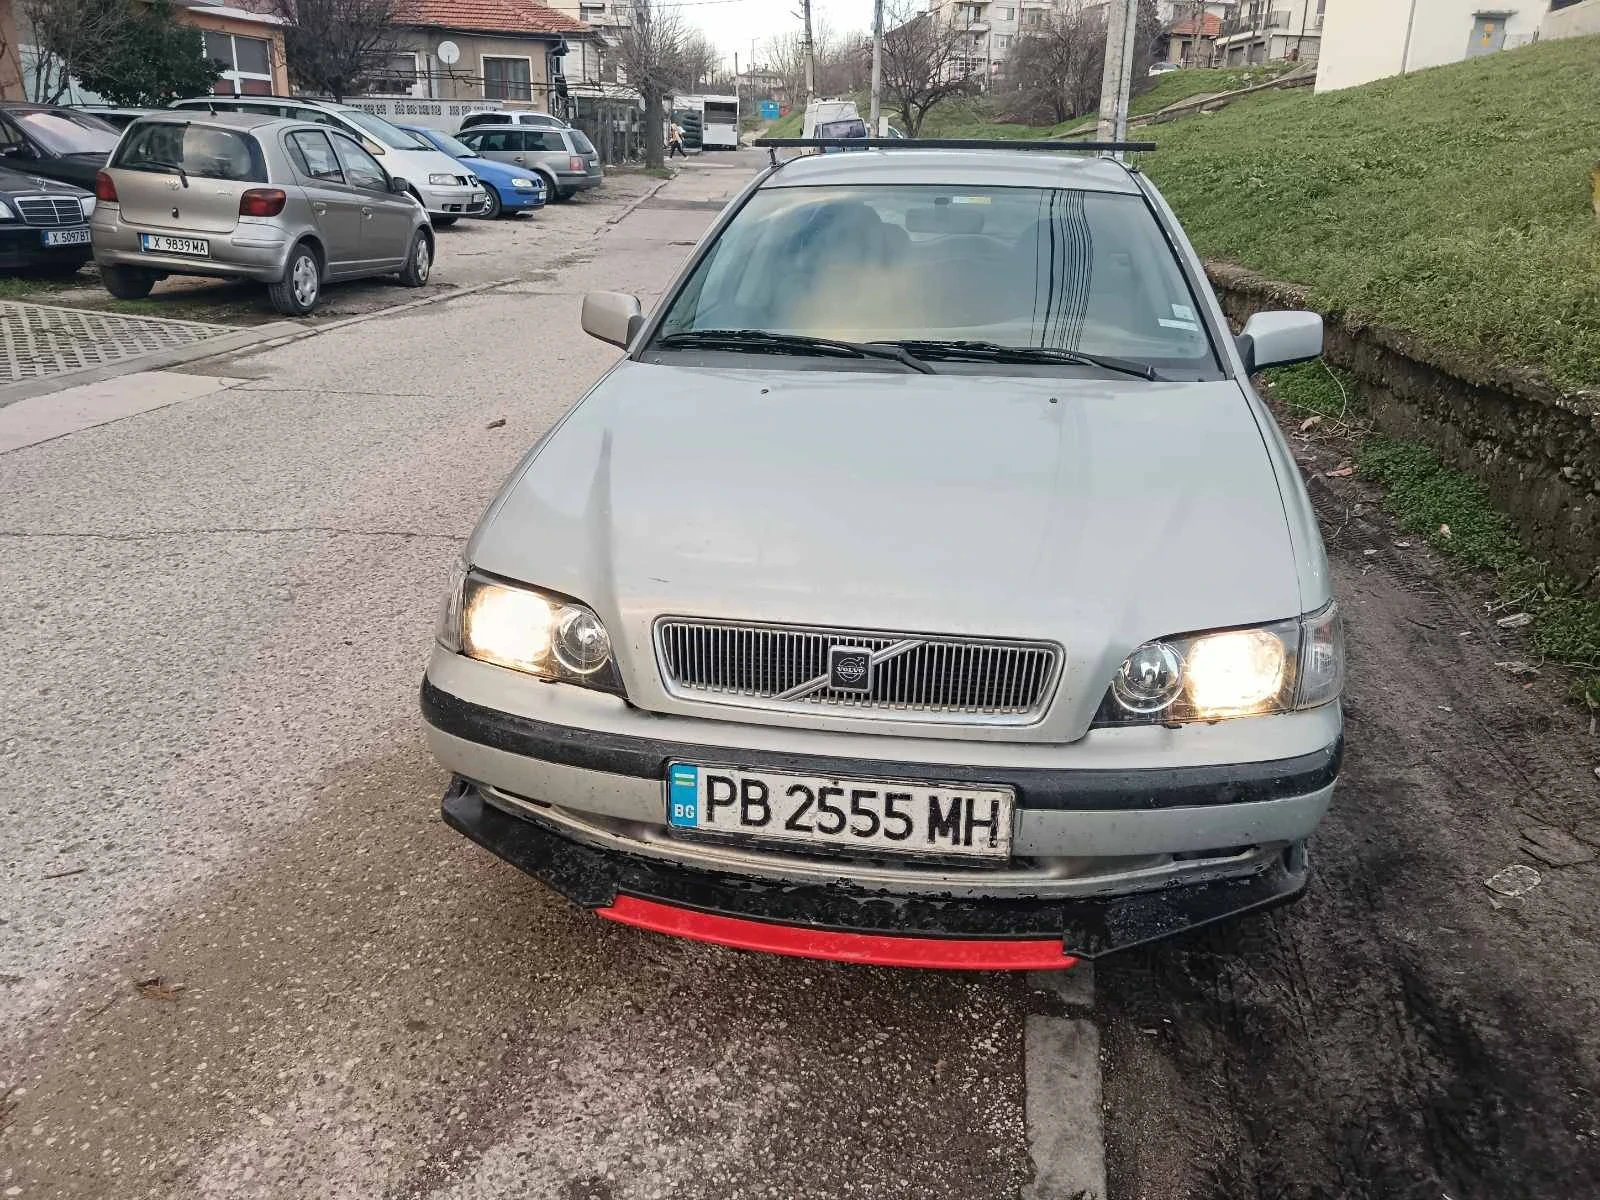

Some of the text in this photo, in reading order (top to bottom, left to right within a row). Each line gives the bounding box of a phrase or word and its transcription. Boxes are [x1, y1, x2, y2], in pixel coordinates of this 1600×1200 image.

[61, 231, 79, 242] 5097
[154, 237, 206, 253] X 9839 MA
[836, 666, 865, 674] VOLVO
[674, 803, 695, 819] BG
[706, 774, 1000, 848] PB 2555 MH
